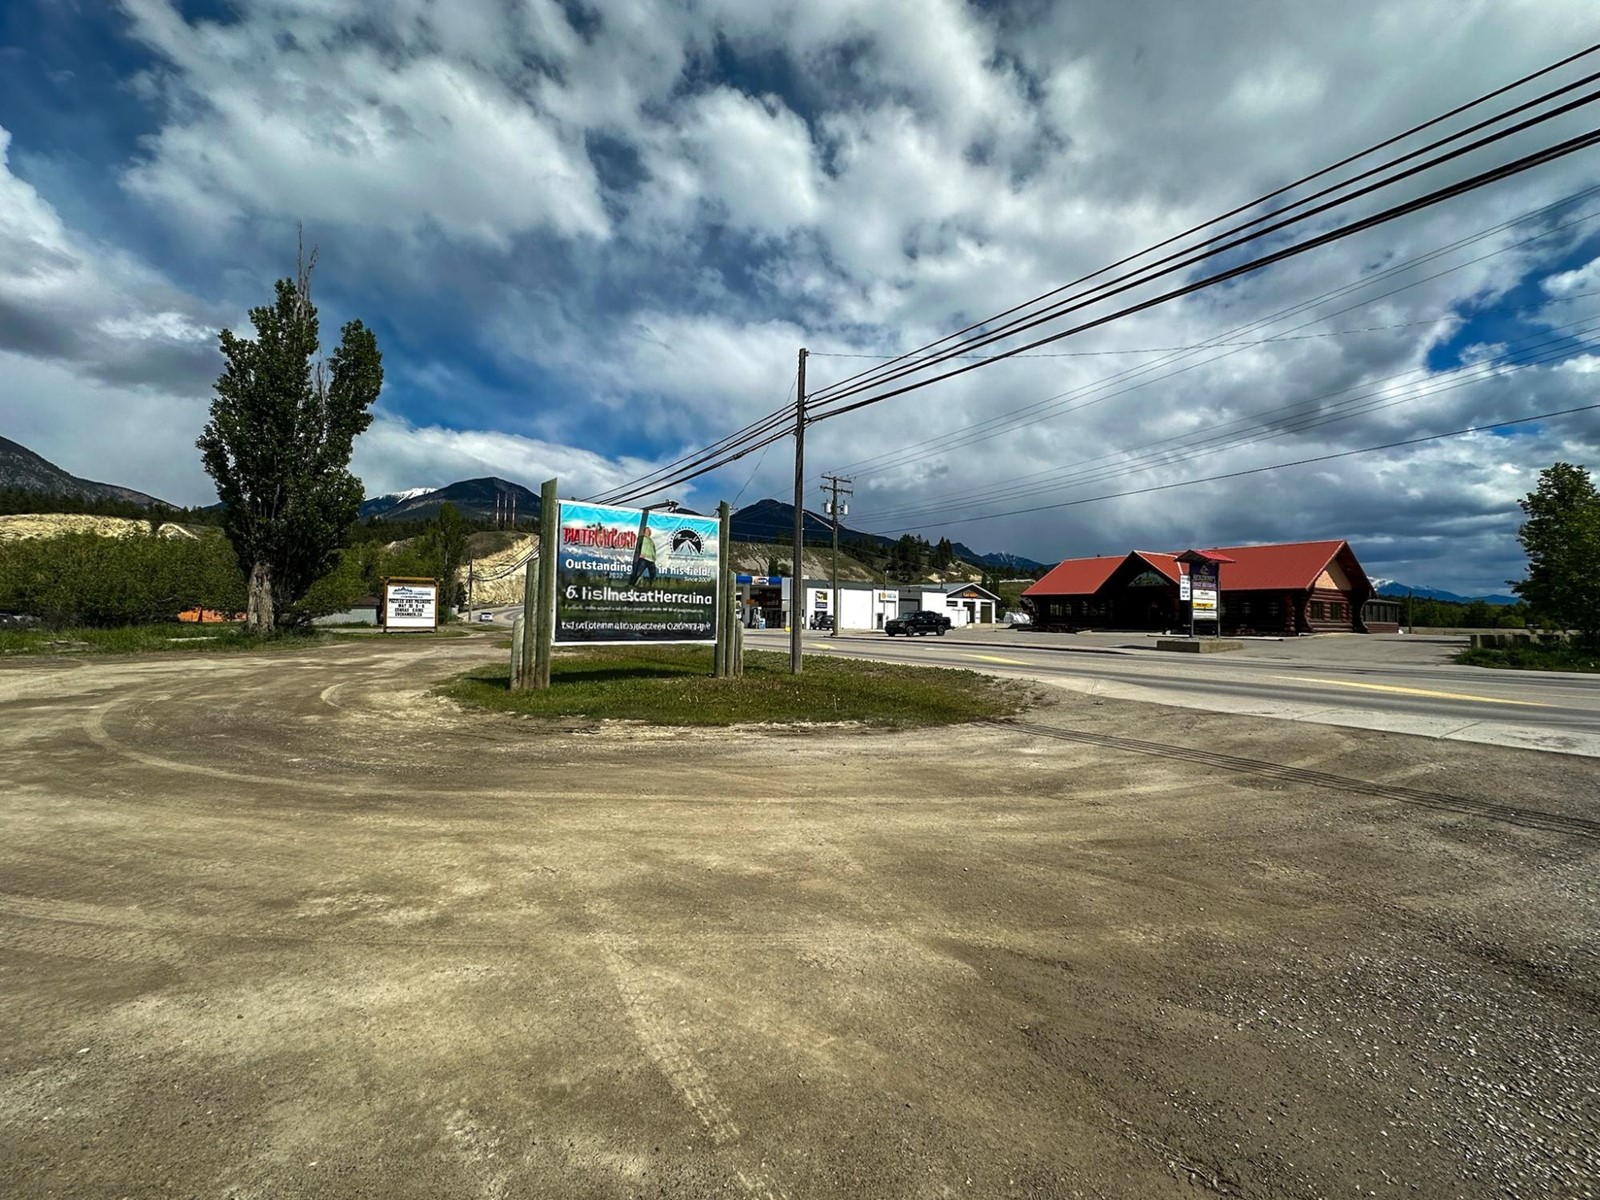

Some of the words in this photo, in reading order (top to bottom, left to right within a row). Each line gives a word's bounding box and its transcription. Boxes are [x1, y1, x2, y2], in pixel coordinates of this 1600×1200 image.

[565, 559, 633, 574] Outstanding
[658, 565, 667, 574] in
[670, 566, 684, 575] his
